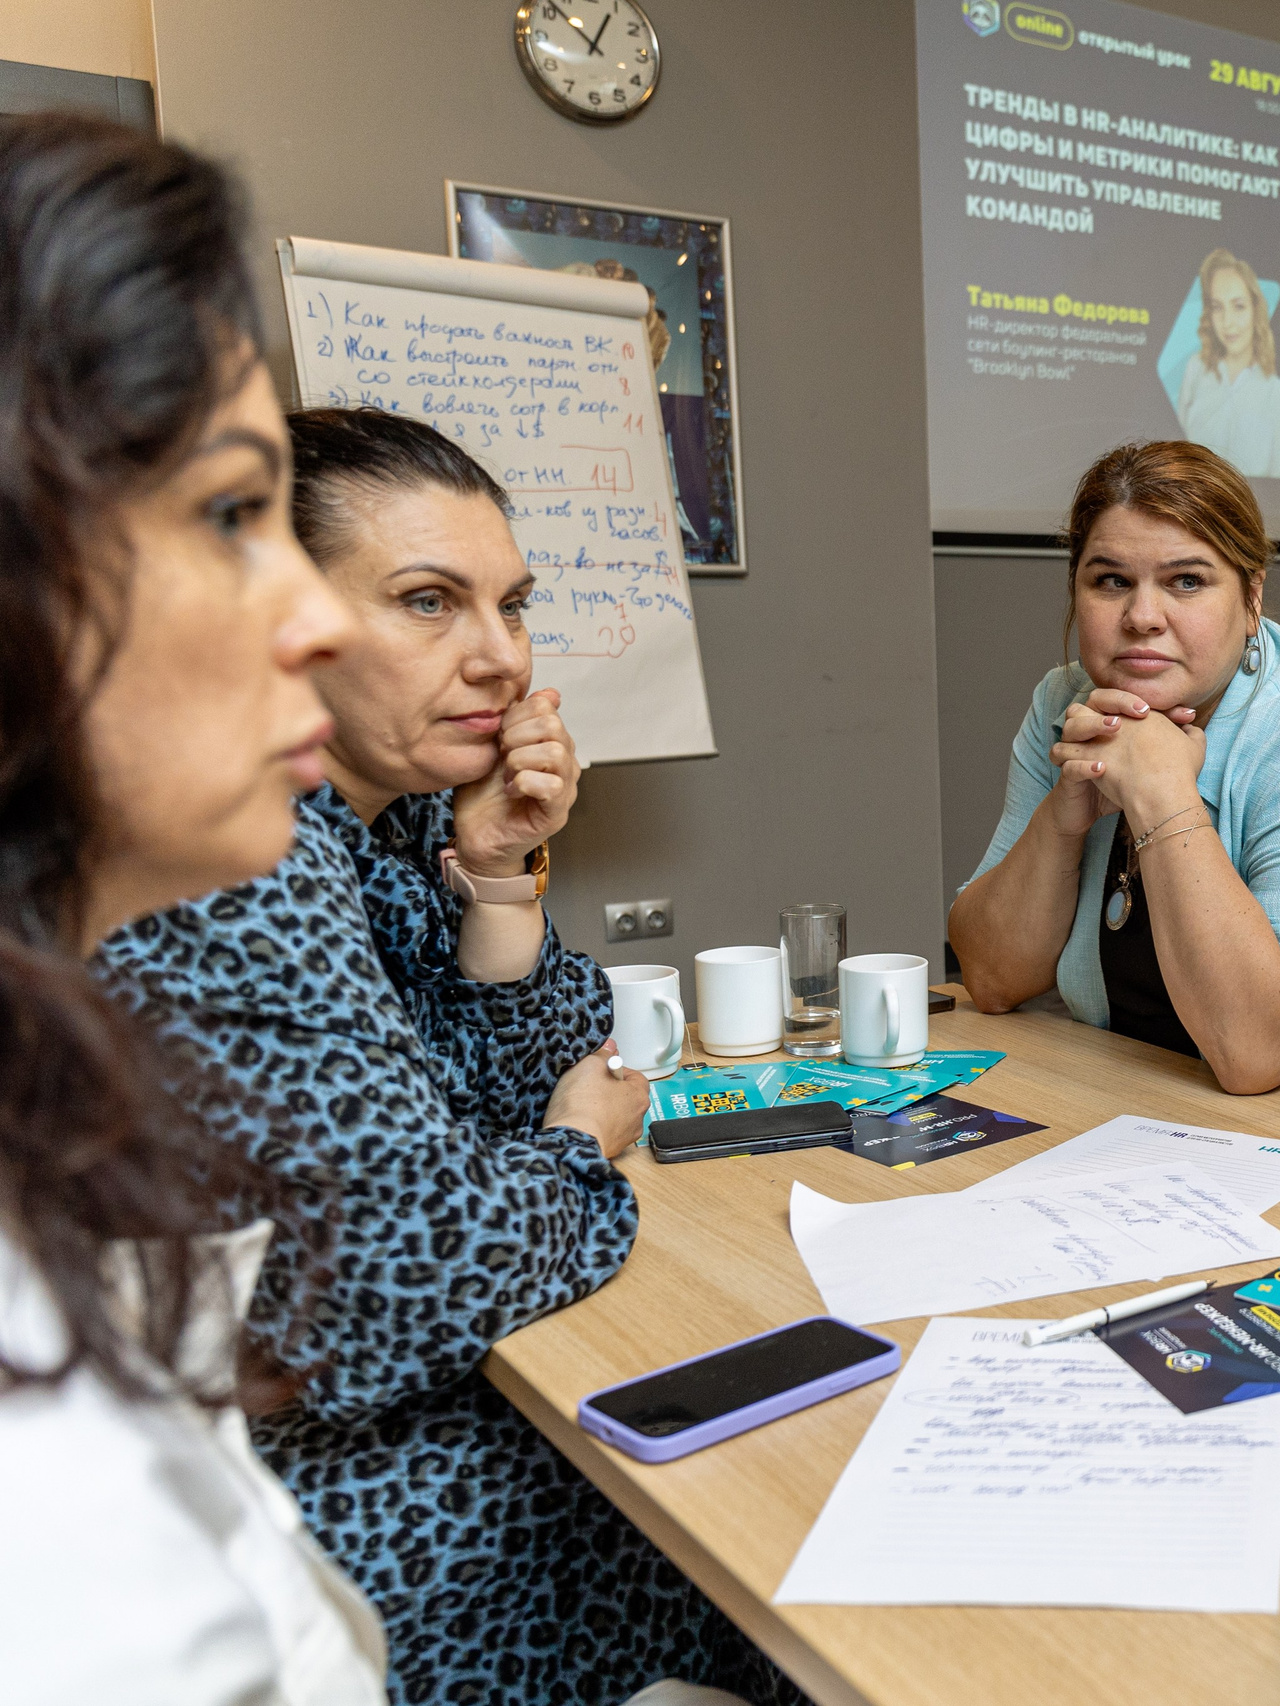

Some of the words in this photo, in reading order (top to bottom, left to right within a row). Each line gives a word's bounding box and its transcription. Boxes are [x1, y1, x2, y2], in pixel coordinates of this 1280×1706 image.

[627, 22, 640, 37] 2
[1015, 14, 1064, 38] online
[1078, 30, 1156, 60] открытый
[1156, 49, 1192, 70] урок
[544, 58, 558, 72] 8
[1209, 59, 1234, 84] 29
[563, 79, 575, 93] 7
[589, 91, 601, 105] 6
[613, 88, 626, 103] 5
[963, 83, 1060, 123] ТРЕНДЫ
[1063, 103, 1078, 126] В
[1081, 107, 1240, 159] HR-АНАЛИТИКЕ:
[1241, 141, 1279, 168] КАК
[964, 120, 1054, 157] ЦИФРЫ
[1058, 138, 1073, 161] И
[1077, 142, 1174, 180] МЕТРИКИ
[1176, 160, 1280, 199] ПОМОГАЮТ
[964, 157, 1089, 198] УЛУЧШИТЬ
[1092, 178, 1222, 221] УПРАВЛЕНИЕ
[966, 194, 1094, 234] КОМАНДОЙ
[345, 300, 390, 329] Как
[967, 285, 1050, 315] Татьяна
[1053, 293, 1150, 325] Федорова
[967, 314, 1059, 340] HR-директор
[1061, 324, 1148, 346] федеральной
[967, 339, 1000, 353] сети
[1002, 340, 1138, 366] боулинг-ресторанов
